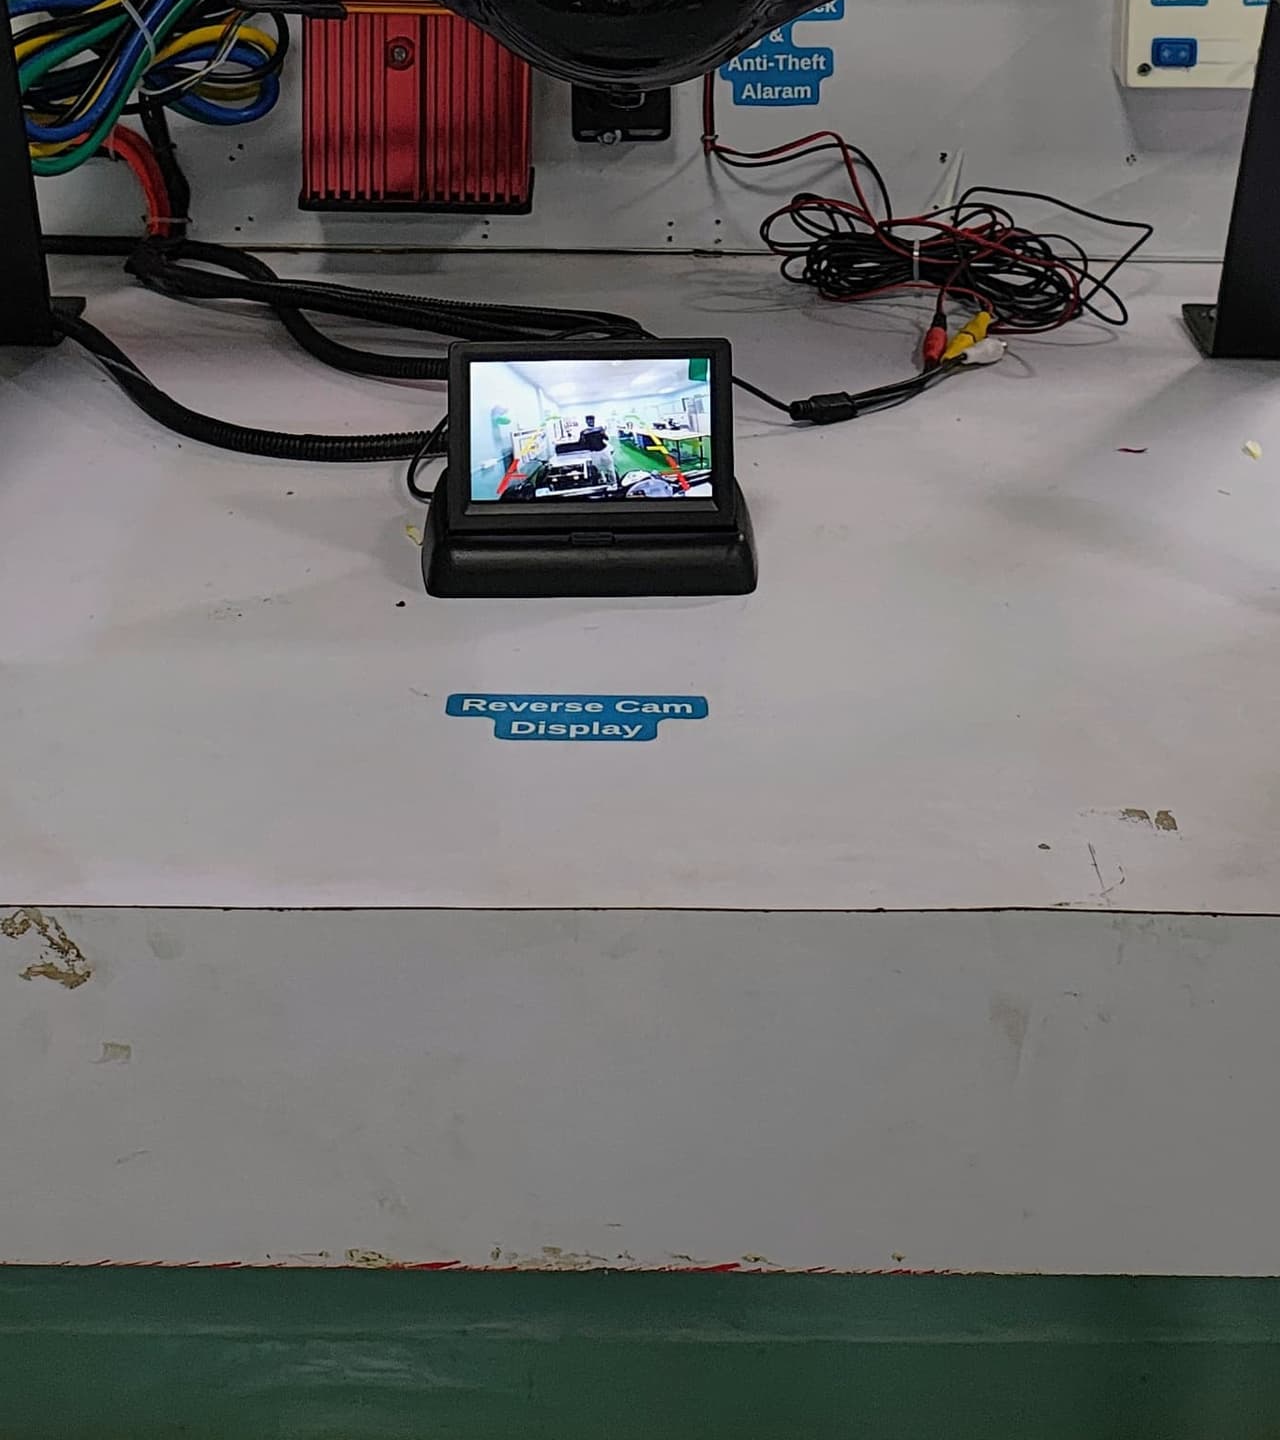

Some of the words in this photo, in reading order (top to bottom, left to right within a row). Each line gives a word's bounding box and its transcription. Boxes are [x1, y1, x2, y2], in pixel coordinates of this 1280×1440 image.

[727, 53, 827, 73] Anti-Theft
[740, 82, 812, 100] Alaram
[461, 697, 604, 714] Reverse
[613, 697, 694, 714] Cam
[509, 720, 643, 739] Display
